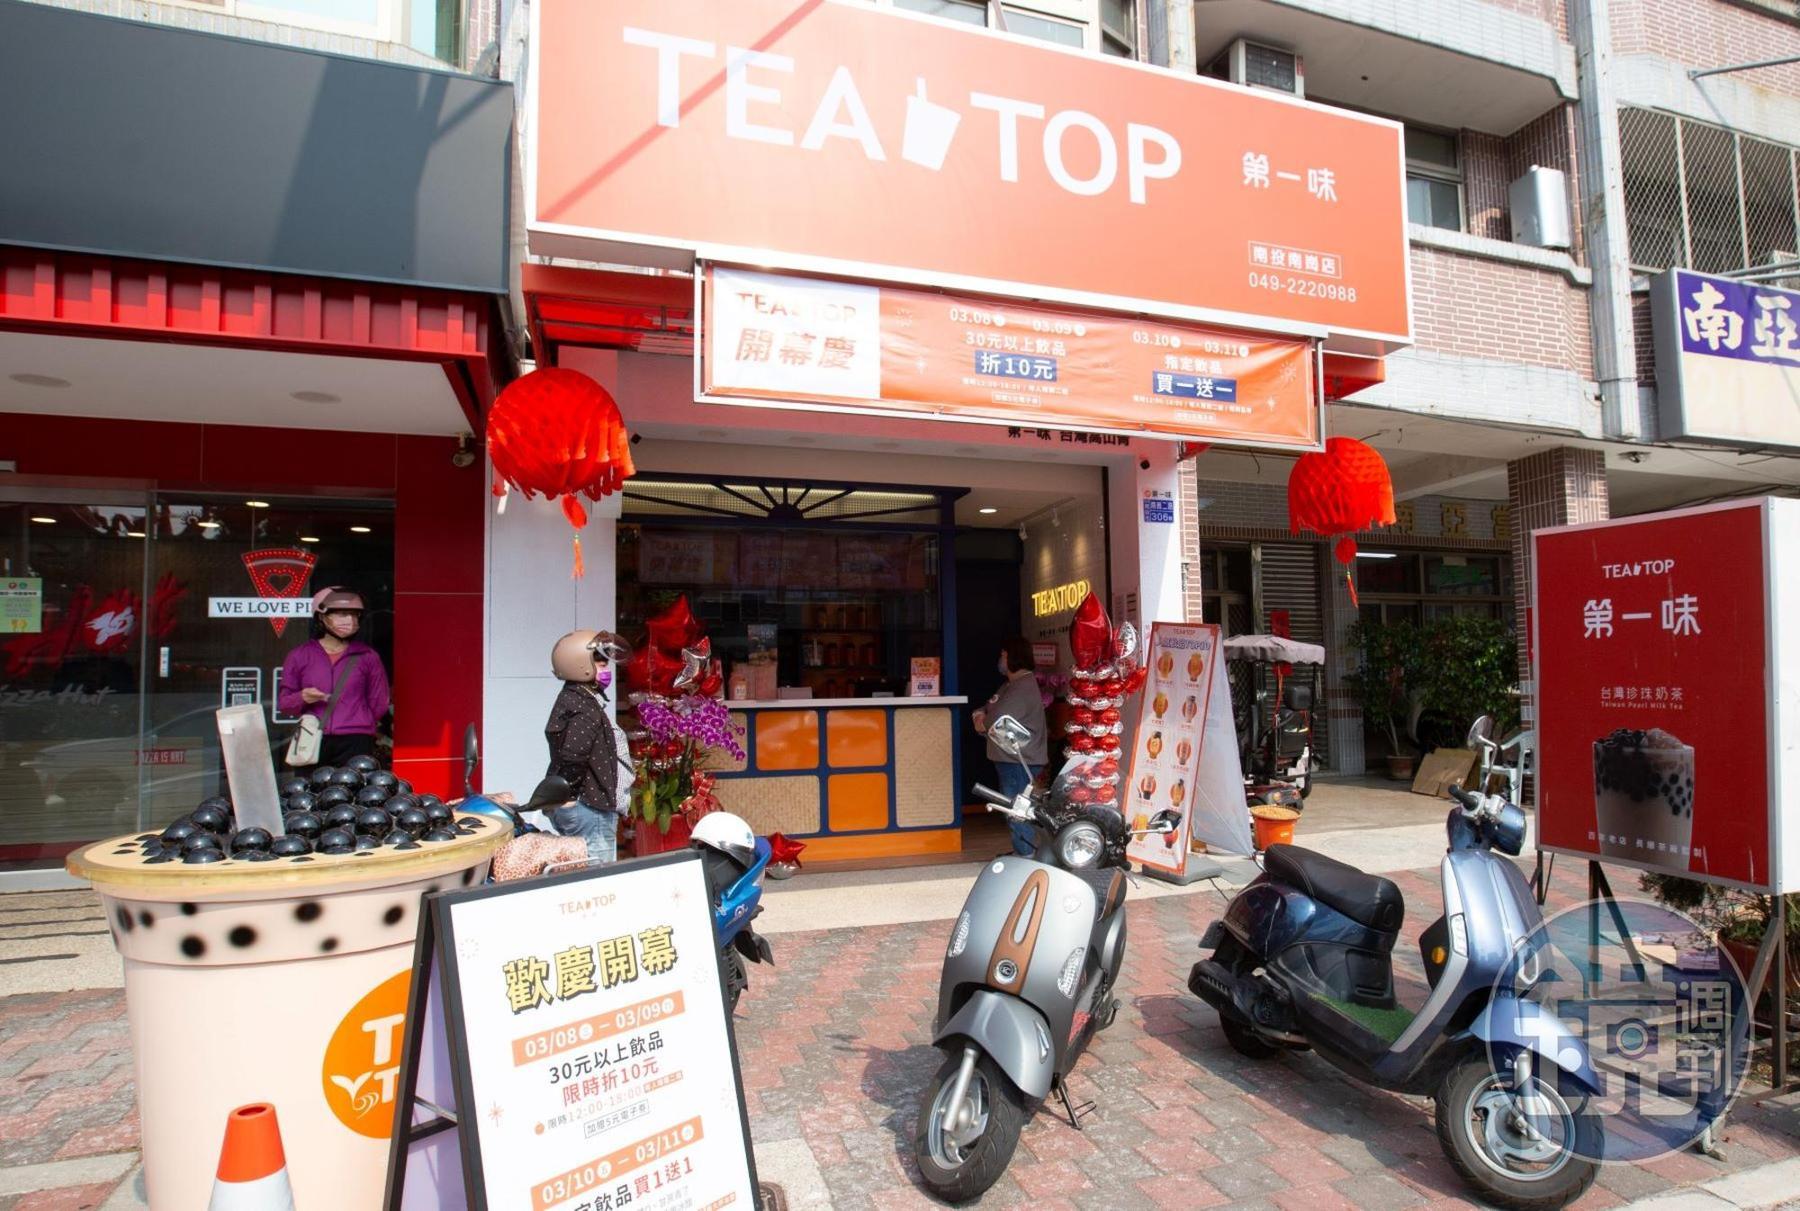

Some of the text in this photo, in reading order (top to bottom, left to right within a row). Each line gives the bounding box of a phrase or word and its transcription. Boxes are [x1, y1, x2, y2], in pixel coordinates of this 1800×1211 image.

[623, 26, 1182, 205] TEA TOP
[1243, 151, 1338, 203] 第一味
[1252, 245, 1337, 275] 南投南崗店
[1248, 271, 1358, 303] 049-2220988
[1683, 281, 1800, 363] 南亞
[965, 331, 1067, 357] 30元以上飲品
[981, 352, 1053, 380] 折10元
[1156, 373, 1233, 398] 買一送一
[1602, 559, 1675, 579] TEA TOP
[216, 602, 243, 613] WE
[247, 602, 290, 613] LOVE
[1583, 593, 1702, 639] 第一味
[1600, 687, 1683, 700] 台灣珍珠奶茶
[503, 925, 679, 1015] 歡慶開幕
[549, 1030, 664, 1085] 30元以上飲品
[562, 1056, 660, 1107] 限時折10元
